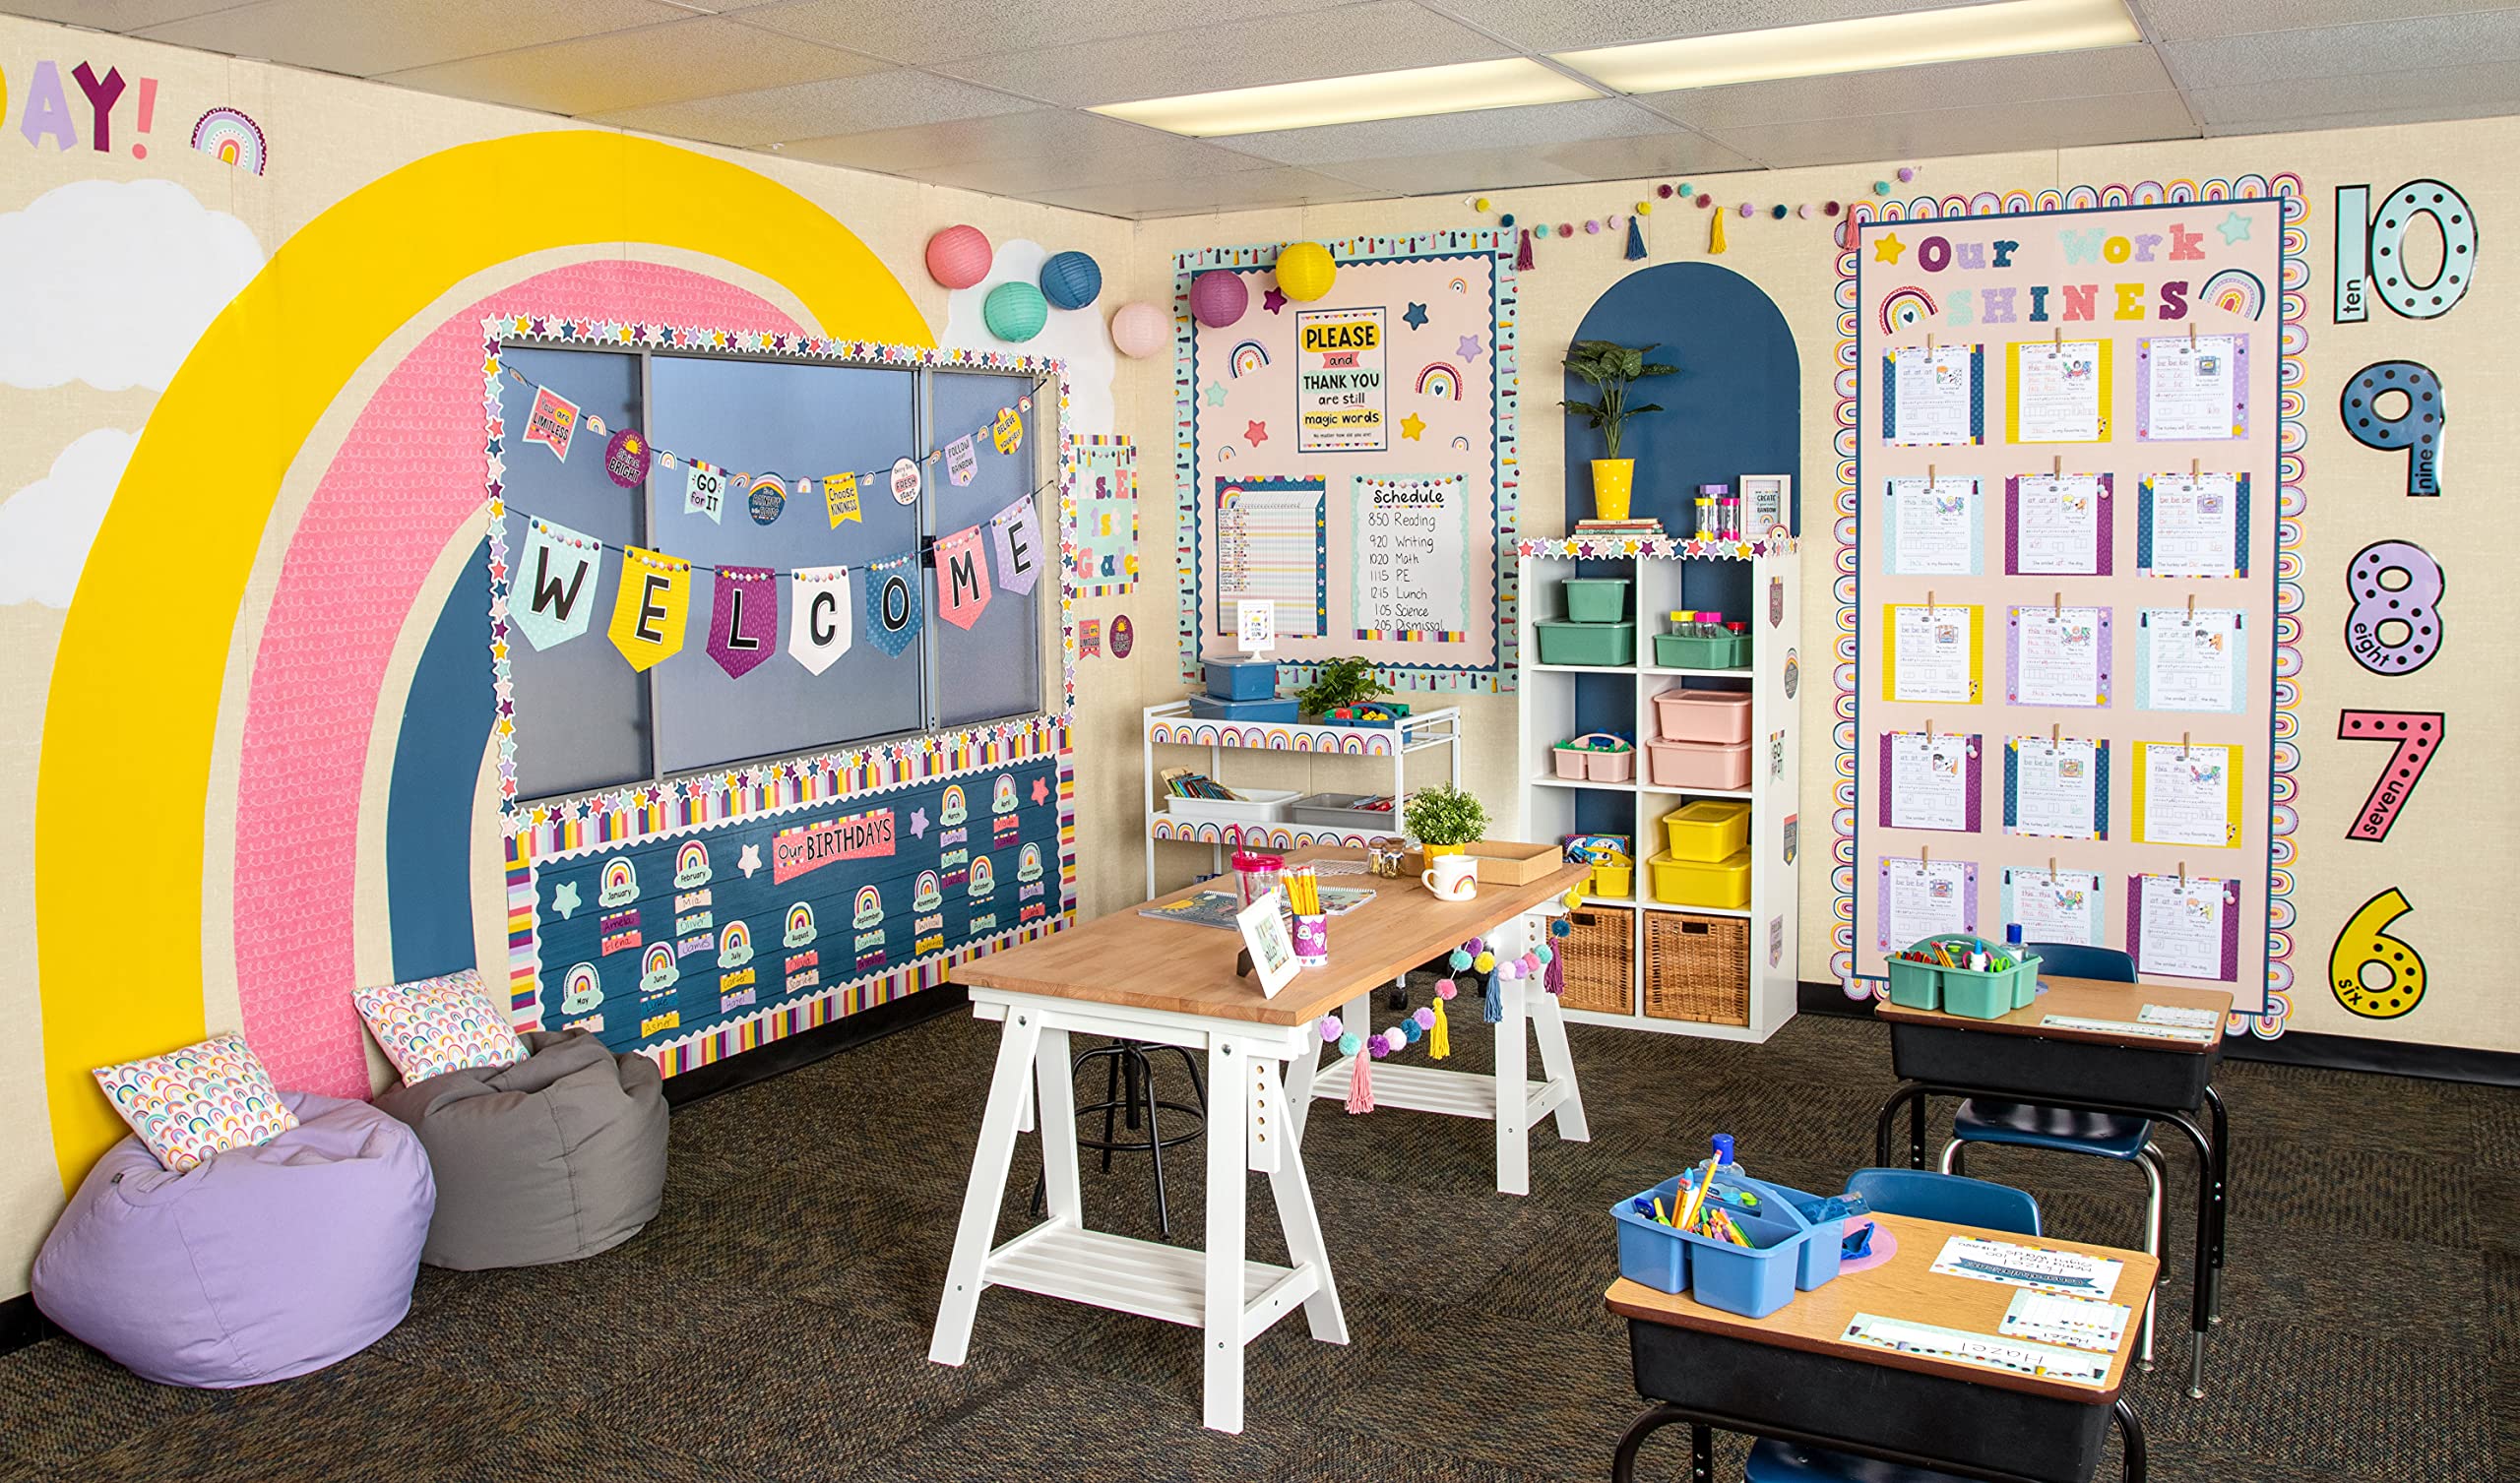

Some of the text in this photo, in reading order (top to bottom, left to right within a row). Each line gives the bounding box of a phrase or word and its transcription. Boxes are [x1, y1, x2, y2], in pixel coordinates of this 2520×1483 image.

[0, 59, 158, 159] AY!
[1919, 222, 2206, 273] Our Work
[2333, 178, 2479, 324] 10
[1946, 280, 2189, 328] SHINES
[2343, 278, 2362, 313] ten
[1306, 325, 1375, 348] PLEASE
[1329, 354, 1353, 366] and
[1303, 373, 1380, 390] THANK YOU
[1318, 393, 1365, 405] are still
[541, 398, 570, 423] You are
[1304, 411, 1380, 427] magic words
[533, 412, 569, 441] LIMITLESS
[996, 415, 1016, 435] BELIEVE
[2340, 359, 2446, 497] 9
[1000, 429, 1021, 449] YOURSELF
[616, 448, 640, 467] Shine
[948, 439, 970, 459] FOLLOW
[608, 459, 640, 483] BRIGHT
[951, 458, 974, 474] RAINBOW
[2415, 448, 2434, 491] nine
[697, 473, 718, 494] GO
[895, 476, 917, 490] FRESH
[1079, 469, 1129, 500] Ms. E
[690, 492, 719, 512] for IT
[828, 486, 854, 502] Choose
[900, 488, 916, 500] start
[1374, 489, 1444, 504] Schedule
[831, 499, 857, 517] KINDNESS
[1090, 507, 1121, 537] 1st
[1394, 512, 1436, 532] Reading
[1395, 535, 1434, 553] Writing
[1077, 546, 1139, 580] Grade
[1396, 553, 1419, 565] Math
[530, 520, 1032, 649] WELCOME
[1396, 587, 1427, 600] Lunch
[1395, 603, 1428, 617] Science
[2345, 539, 2445, 677] 8
[1396, 619, 1444, 632] Dismissal
[2028, 627, 2040, 636] this
[2353, 622, 2391, 668] eight
[2337, 709, 2445, 843] 7
[2362, 779, 2406, 835] seven
[779, 819, 892, 860] Our BIRTHDAYS
[680, 871, 706, 884] February
[1021, 867, 1040, 878] December
[607, 889, 632, 901] January
[974, 882, 989, 892] October
[682, 897, 702, 908] Mia
[917, 896, 939, 907] November
[680, 917, 706, 931] Oliver
[856, 911, 880, 925] September
[604, 938, 632, 953] Elena
[791, 931, 809, 943] August
[681, 939, 711, 954] James
[2328, 886, 2427, 1020] 6
[730, 952, 742, 960] July
[653, 973, 668, 983] June
[723, 972, 747, 990] Carter
[577, 996, 590, 1006] May
[2338, 977, 2364, 1008] six
[645, 998, 669, 1013] Luke
[725, 996, 746, 1009] Hazel
[645, 1018, 672, 1035] Asher
[2006, 1249, 2048, 1264] Words
[2003, 1259, 2063, 1275] Hazel
[2044, 1332, 2090, 1344] Hazel
[1962, 1342, 2044, 1365] Hazel
